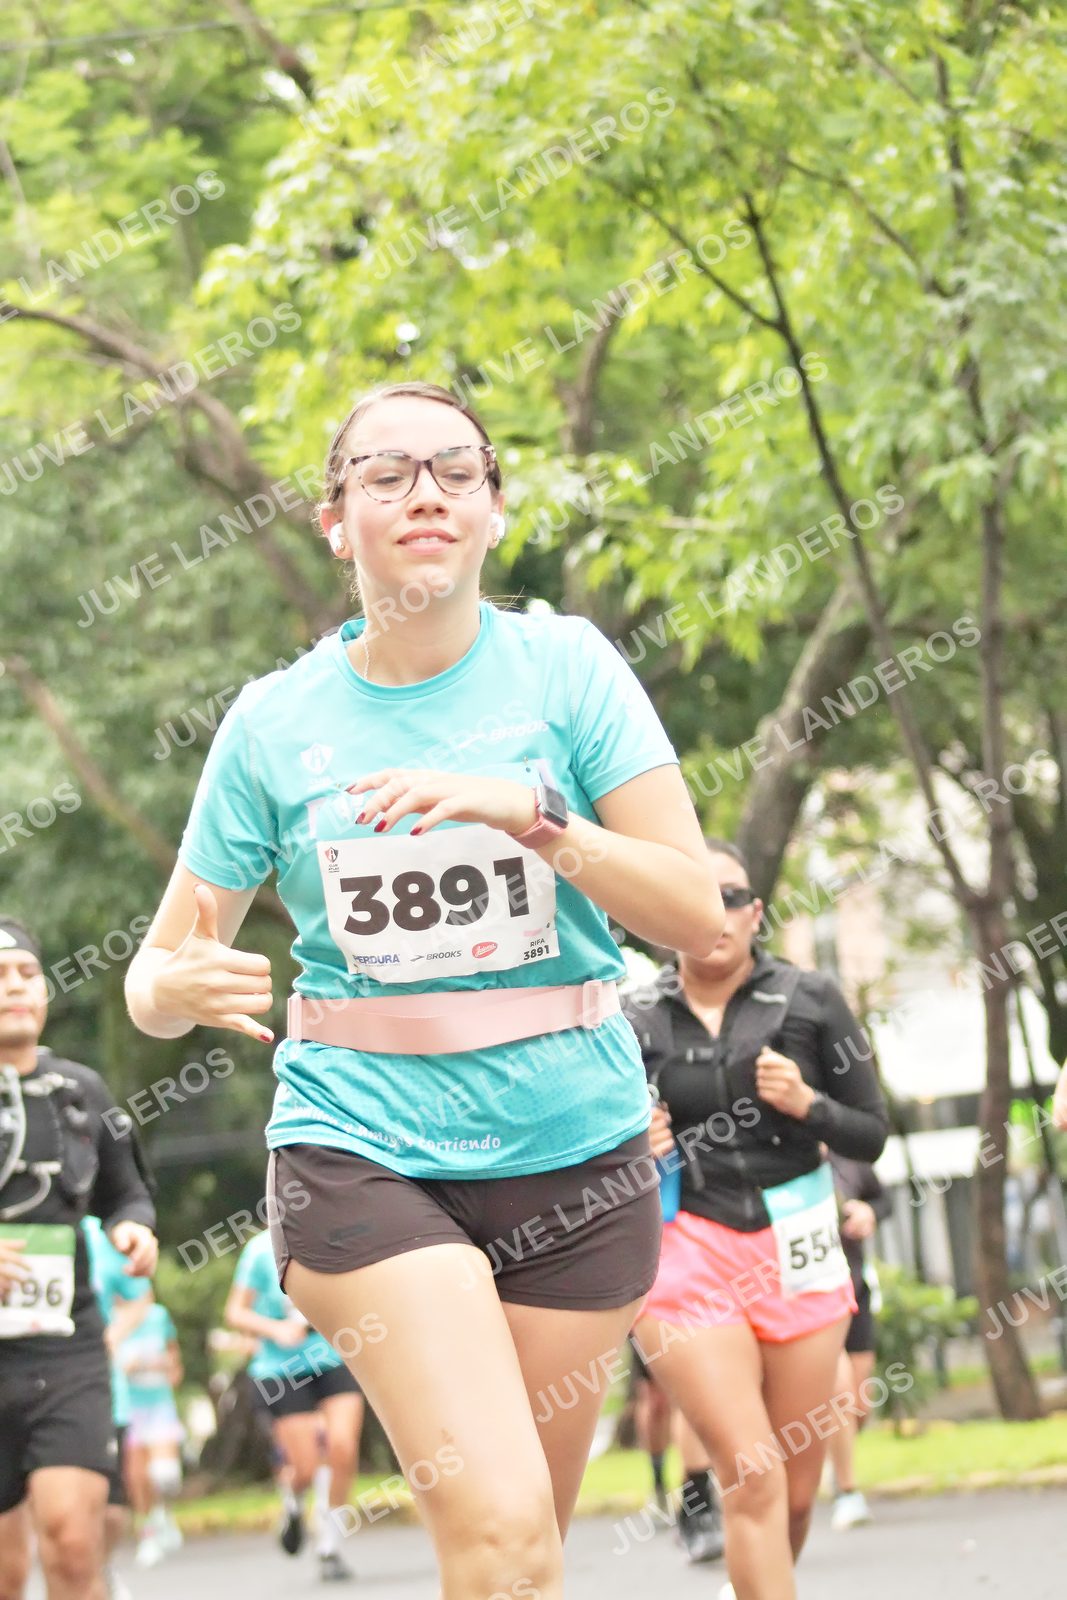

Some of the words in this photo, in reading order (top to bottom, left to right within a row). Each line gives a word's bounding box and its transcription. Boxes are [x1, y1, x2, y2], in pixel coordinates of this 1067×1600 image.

[339, 856, 530, 936] 3891
[530, 938, 546, 947] RIFA
[426, 949, 462, 961] BROOKS
[523, 945, 550, 961] 3891
[2, 1278, 62, 1308] 96
